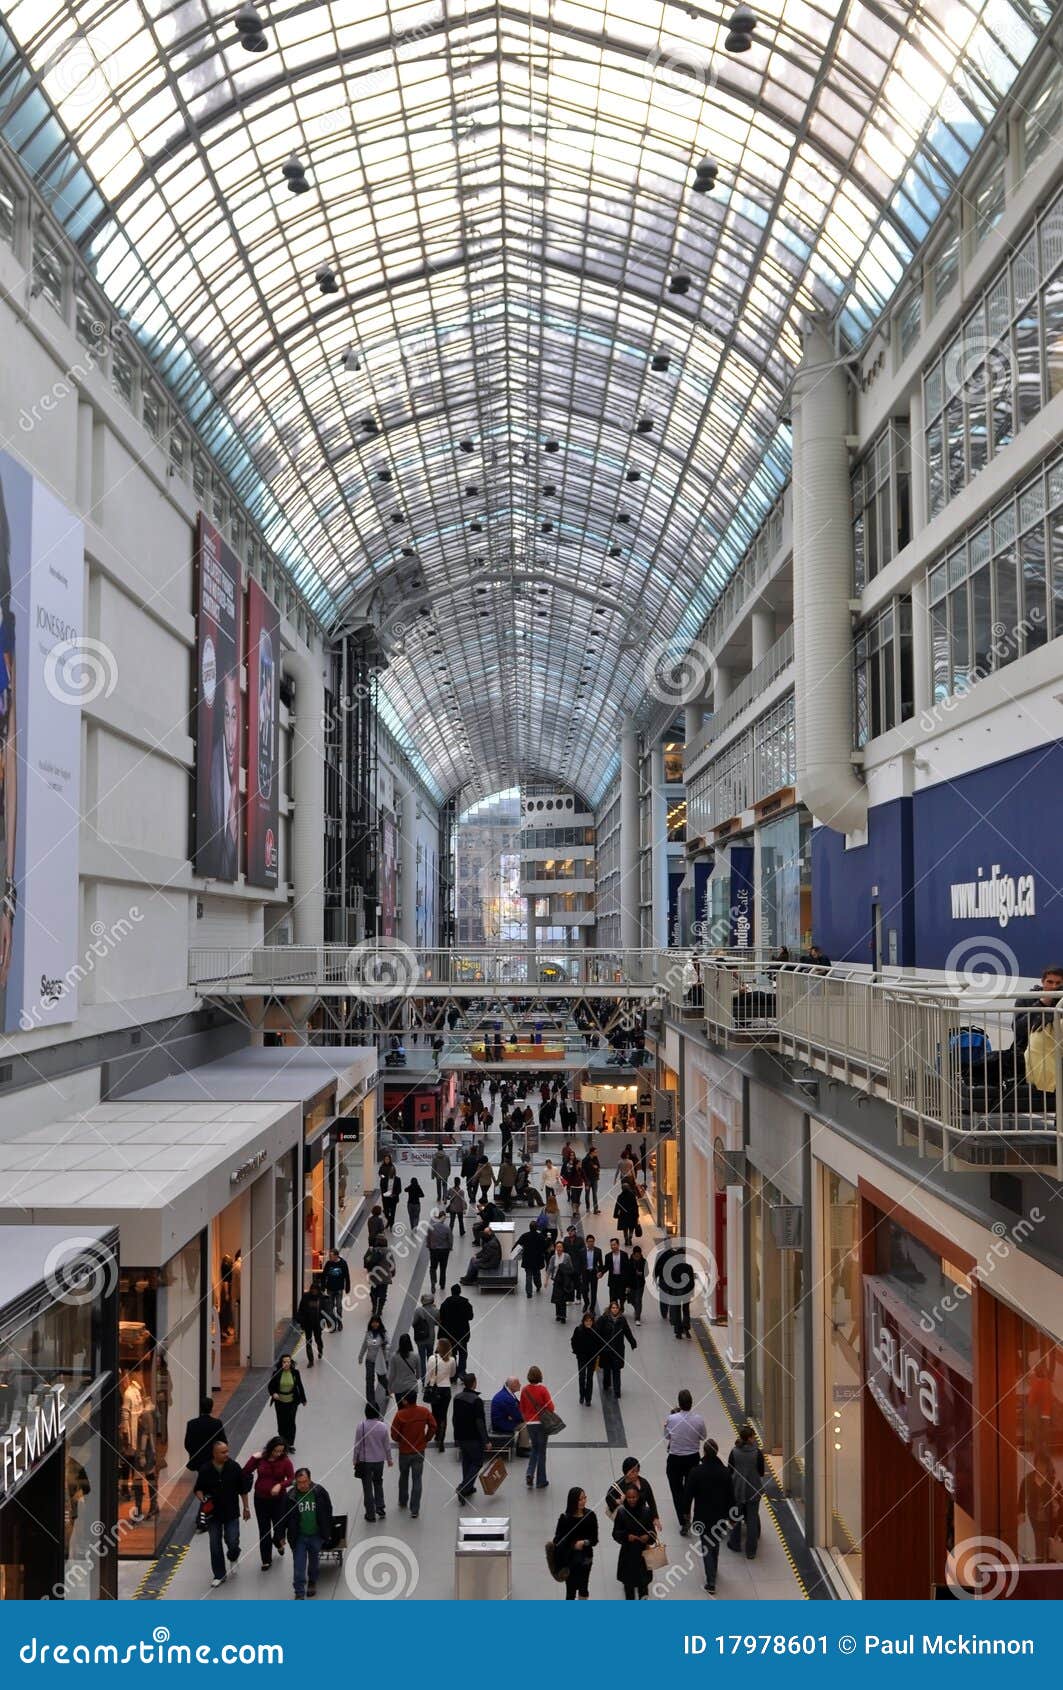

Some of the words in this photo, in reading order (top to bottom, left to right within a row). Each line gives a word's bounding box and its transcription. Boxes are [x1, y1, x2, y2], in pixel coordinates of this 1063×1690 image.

[736, 889, 749, 915] Café
[950, 864, 1036, 928] www.indigo.ca
[733, 916, 751, 948] Indigo
[871, 1312, 940, 1426] Laura
[2, 1384, 66, 1491] FEMME
